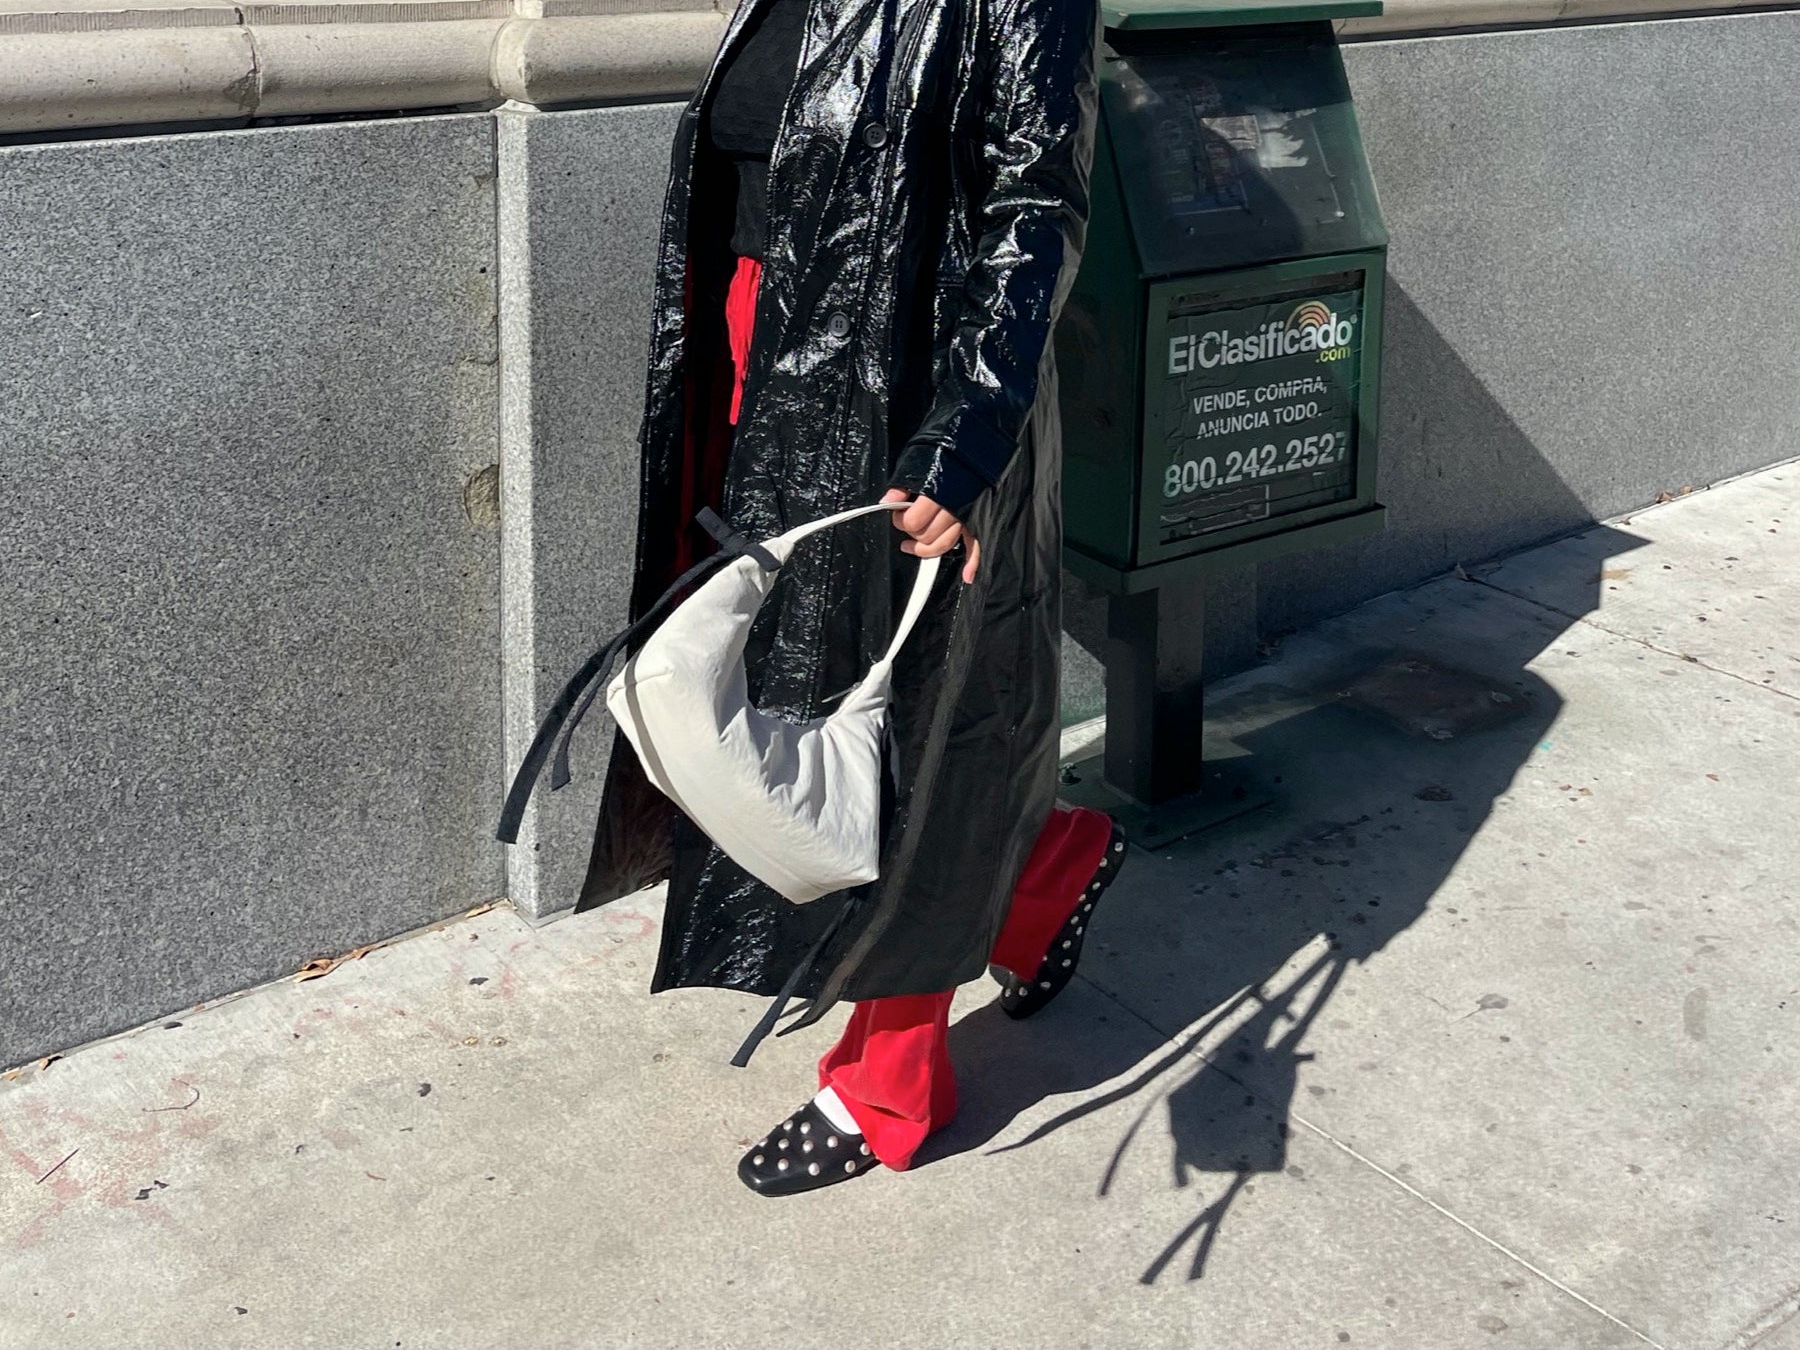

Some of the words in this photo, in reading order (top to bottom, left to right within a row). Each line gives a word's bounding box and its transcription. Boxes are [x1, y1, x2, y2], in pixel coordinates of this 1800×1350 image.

[1193, 390, 1250, 415] VENDE,
[1255, 376, 1327, 404] COMPRA,
[1196, 411, 1269, 439] ANUNCIA
[1273, 401, 1322, 424] TODO.
[1163, 432, 1346, 498] 800.242.2527
